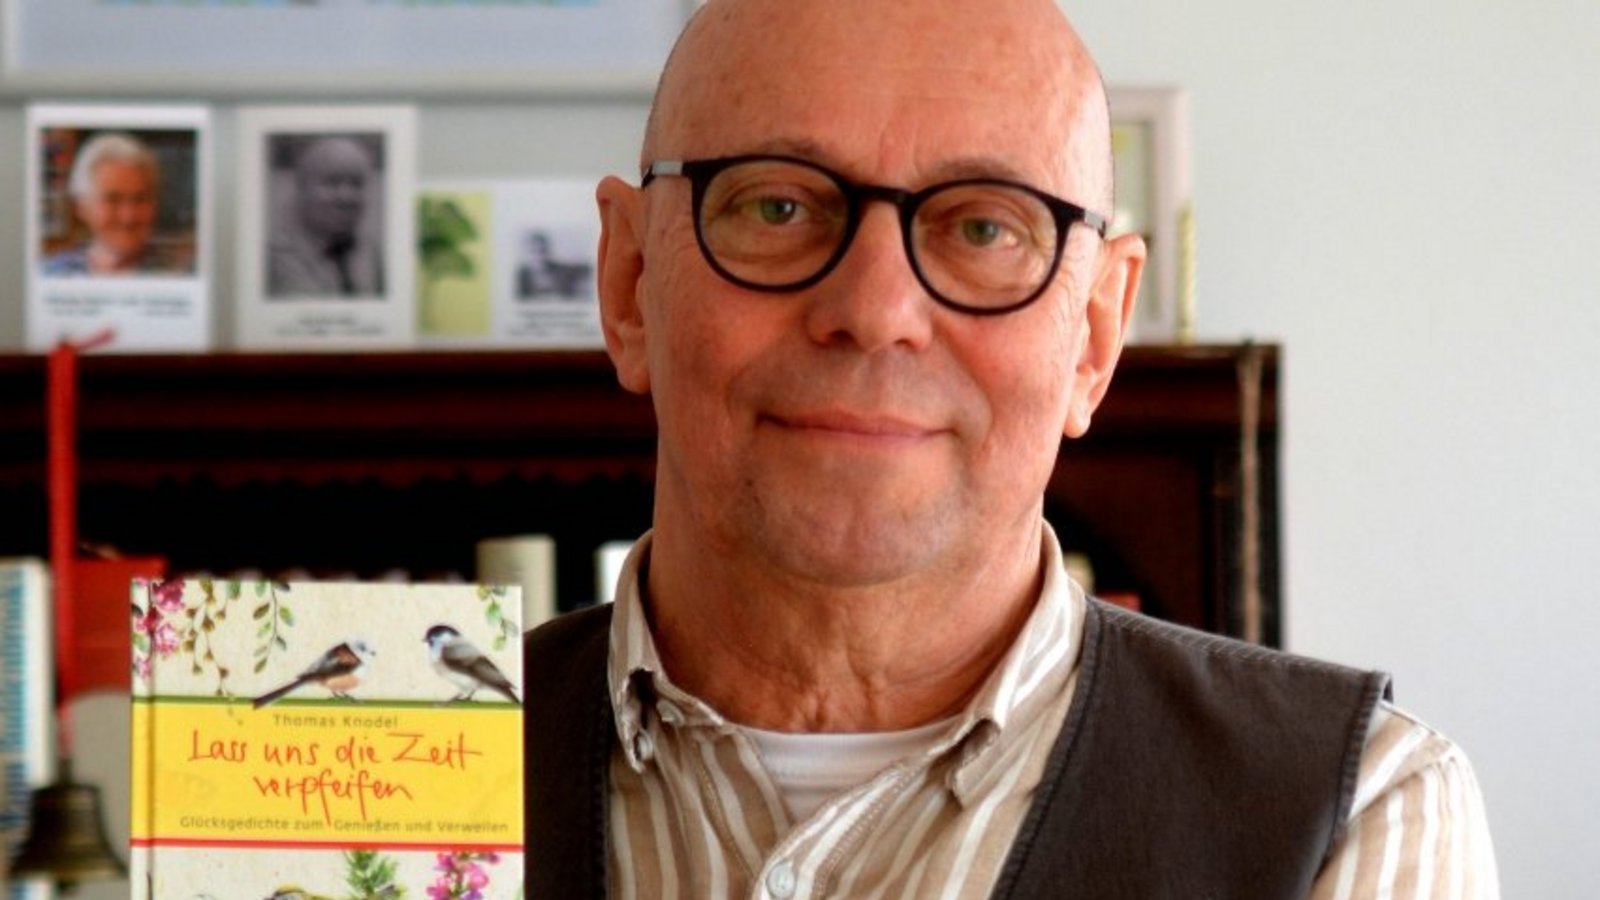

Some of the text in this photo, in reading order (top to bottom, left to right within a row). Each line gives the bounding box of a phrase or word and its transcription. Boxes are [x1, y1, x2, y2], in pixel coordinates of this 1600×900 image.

[273, 714, 336, 728] Thomas
[187, 729, 483, 771] Lass uns die Zeit
[252, 768, 413, 827] verpfeifen
[179, 815, 509, 833] Glücksgedichte zum Genießen und Verweilen
